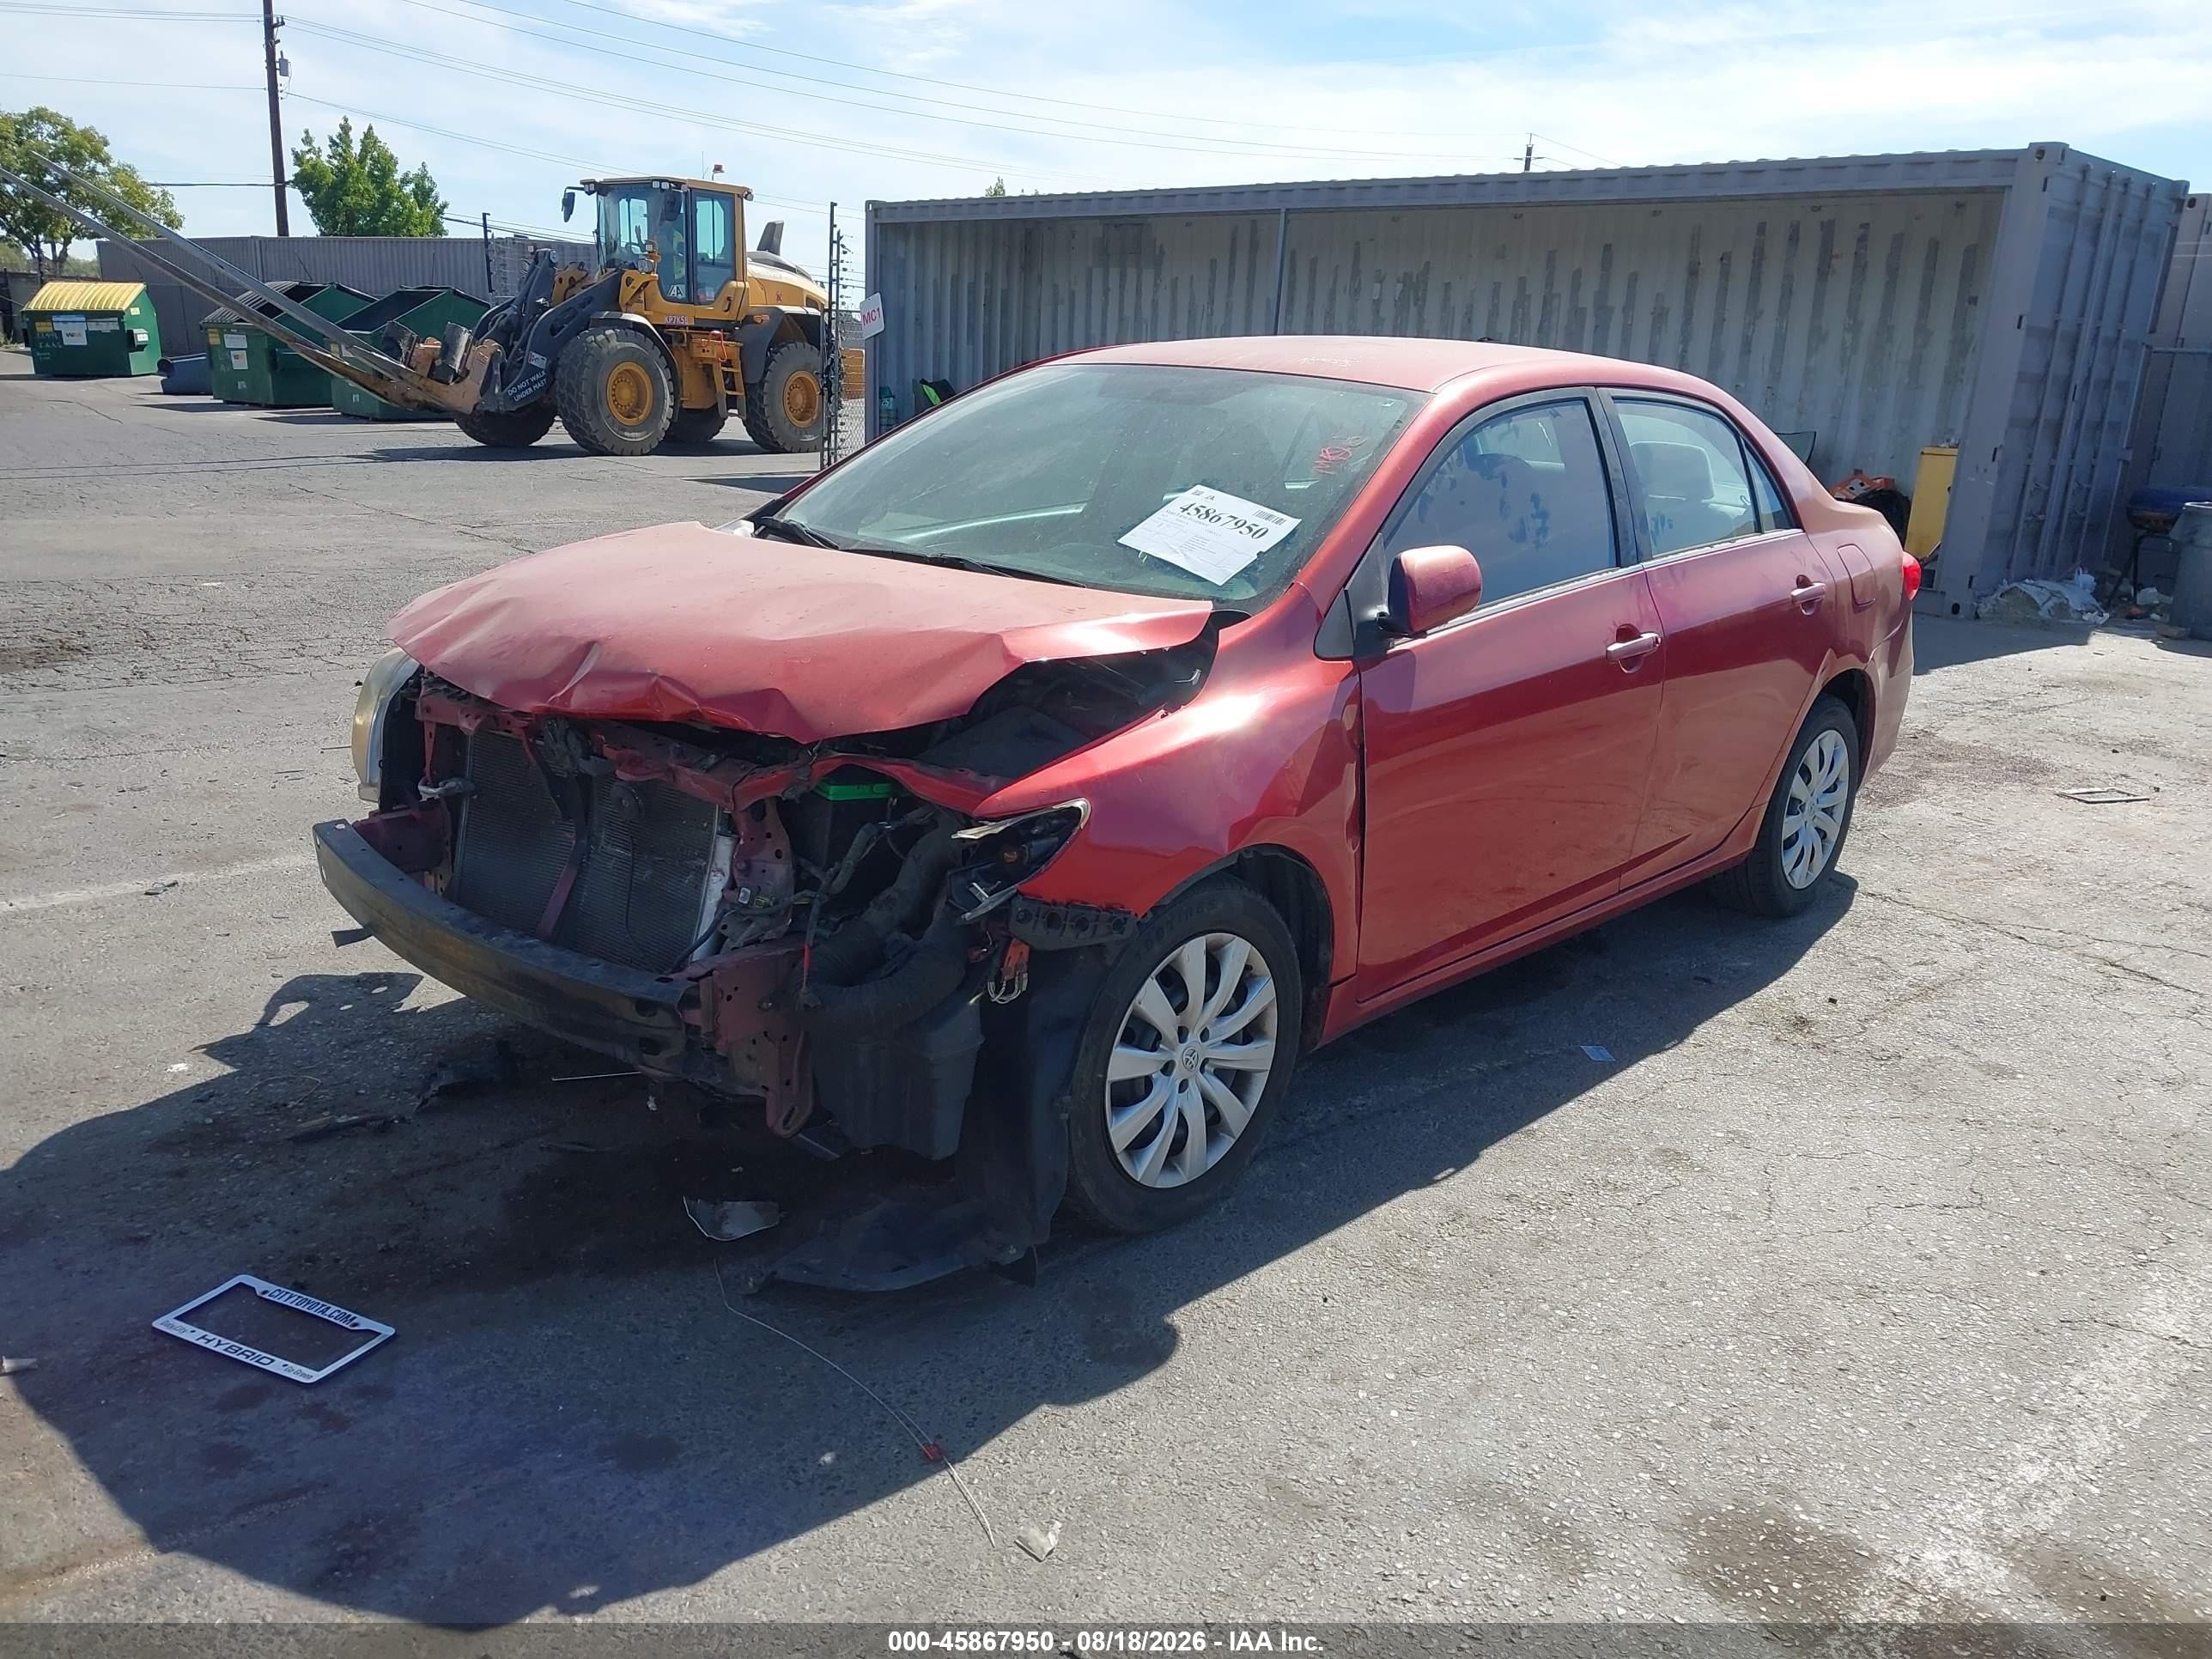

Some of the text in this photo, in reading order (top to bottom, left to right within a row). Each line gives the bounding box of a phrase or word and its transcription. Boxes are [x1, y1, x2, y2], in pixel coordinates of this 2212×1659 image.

[862, 307, 881, 326] MC1
[507, 370, 547, 396] DO NOT WALK
[514, 378, 548, 402] UNDER MAST
[1179, 502, 1269, 539] 45867950
[268, 1288, 358, 1326] CITYTOYOTA.COM
[195, 1334, 276, 1366] HYBRID
